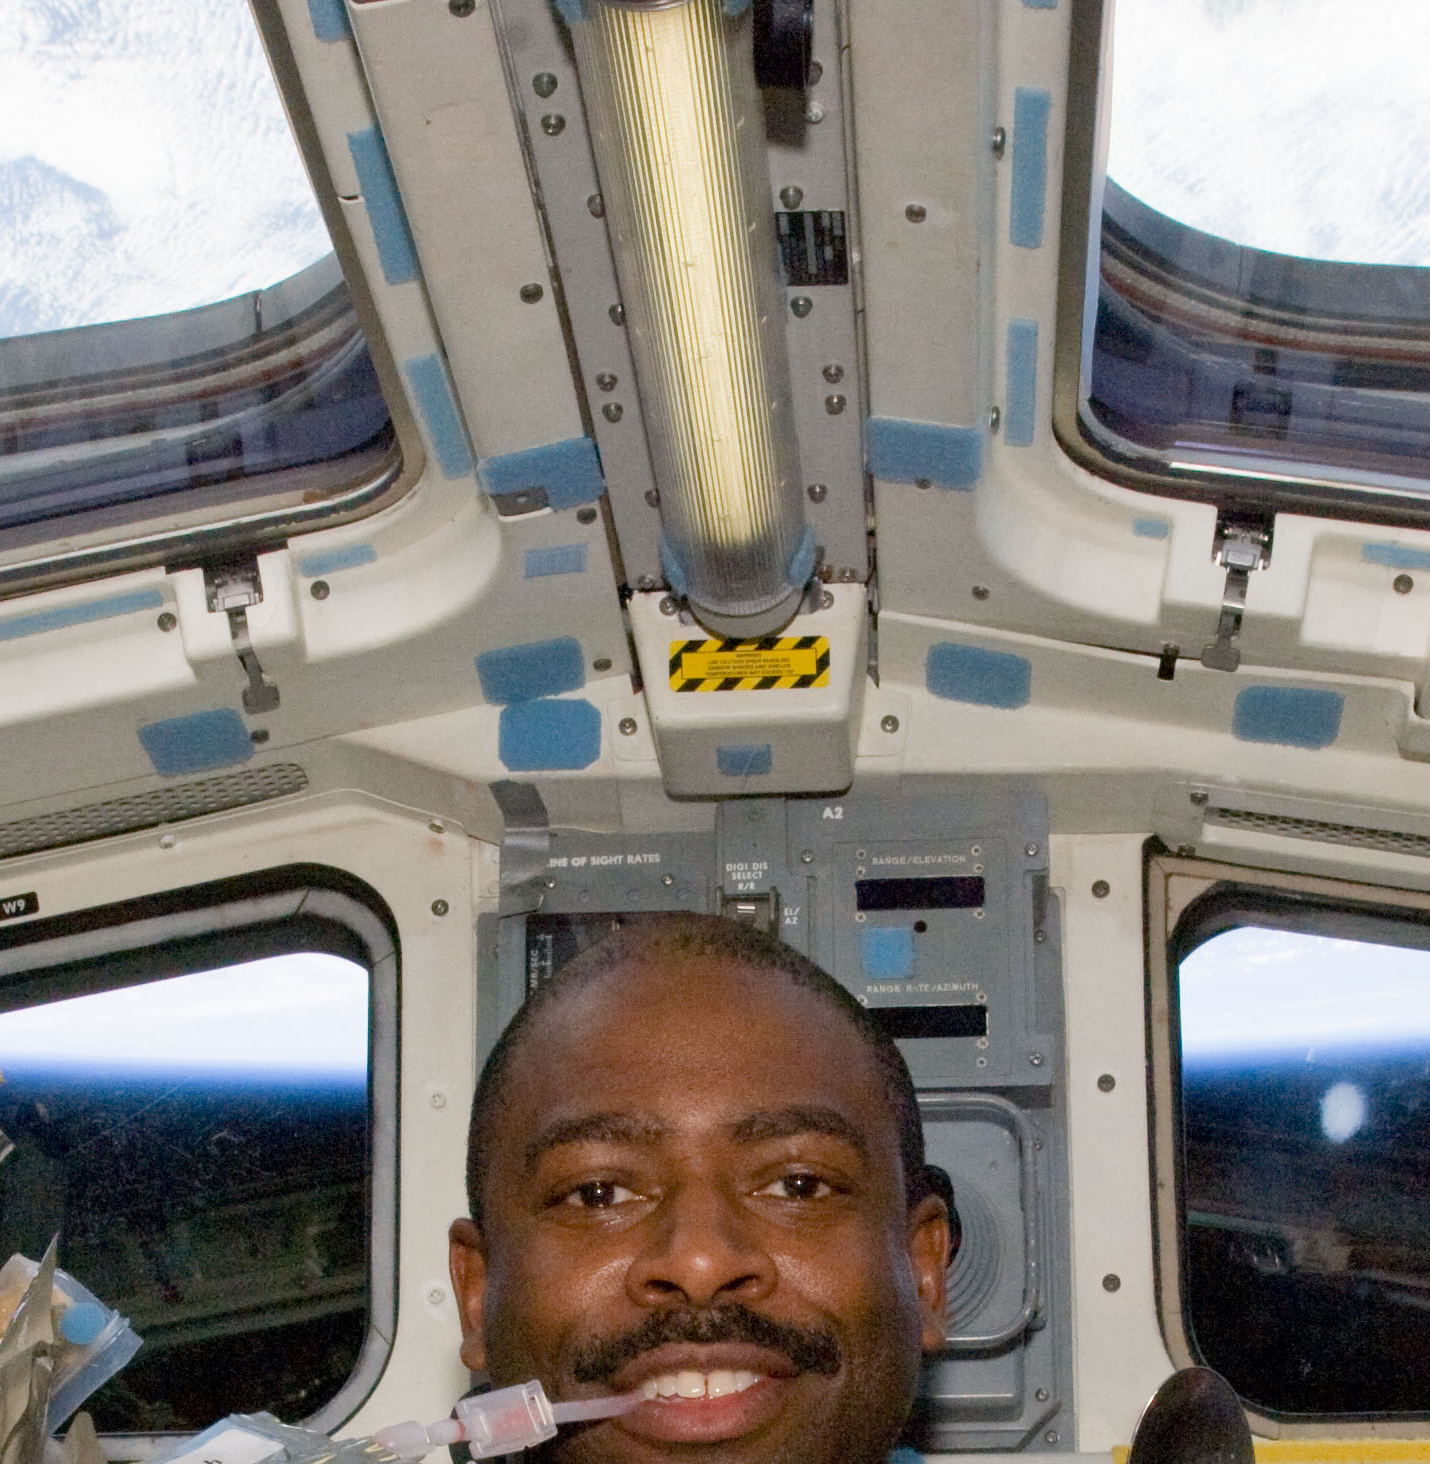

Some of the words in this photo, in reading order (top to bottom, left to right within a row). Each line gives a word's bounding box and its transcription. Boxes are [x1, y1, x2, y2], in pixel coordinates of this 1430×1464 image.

[822, 807, 844, 819] A2
[571, 857, 587, 867] OF
[591, 855, 624, 866] SIGHT
[627, 854, 660, 864] RATES
[871, 854, 967, 866] RANGE/ELEVATION
[732, 871, 763, 880] SELECT
[1, 899, 26, 914] W9
[866, 983, 900, 994] RANGE
